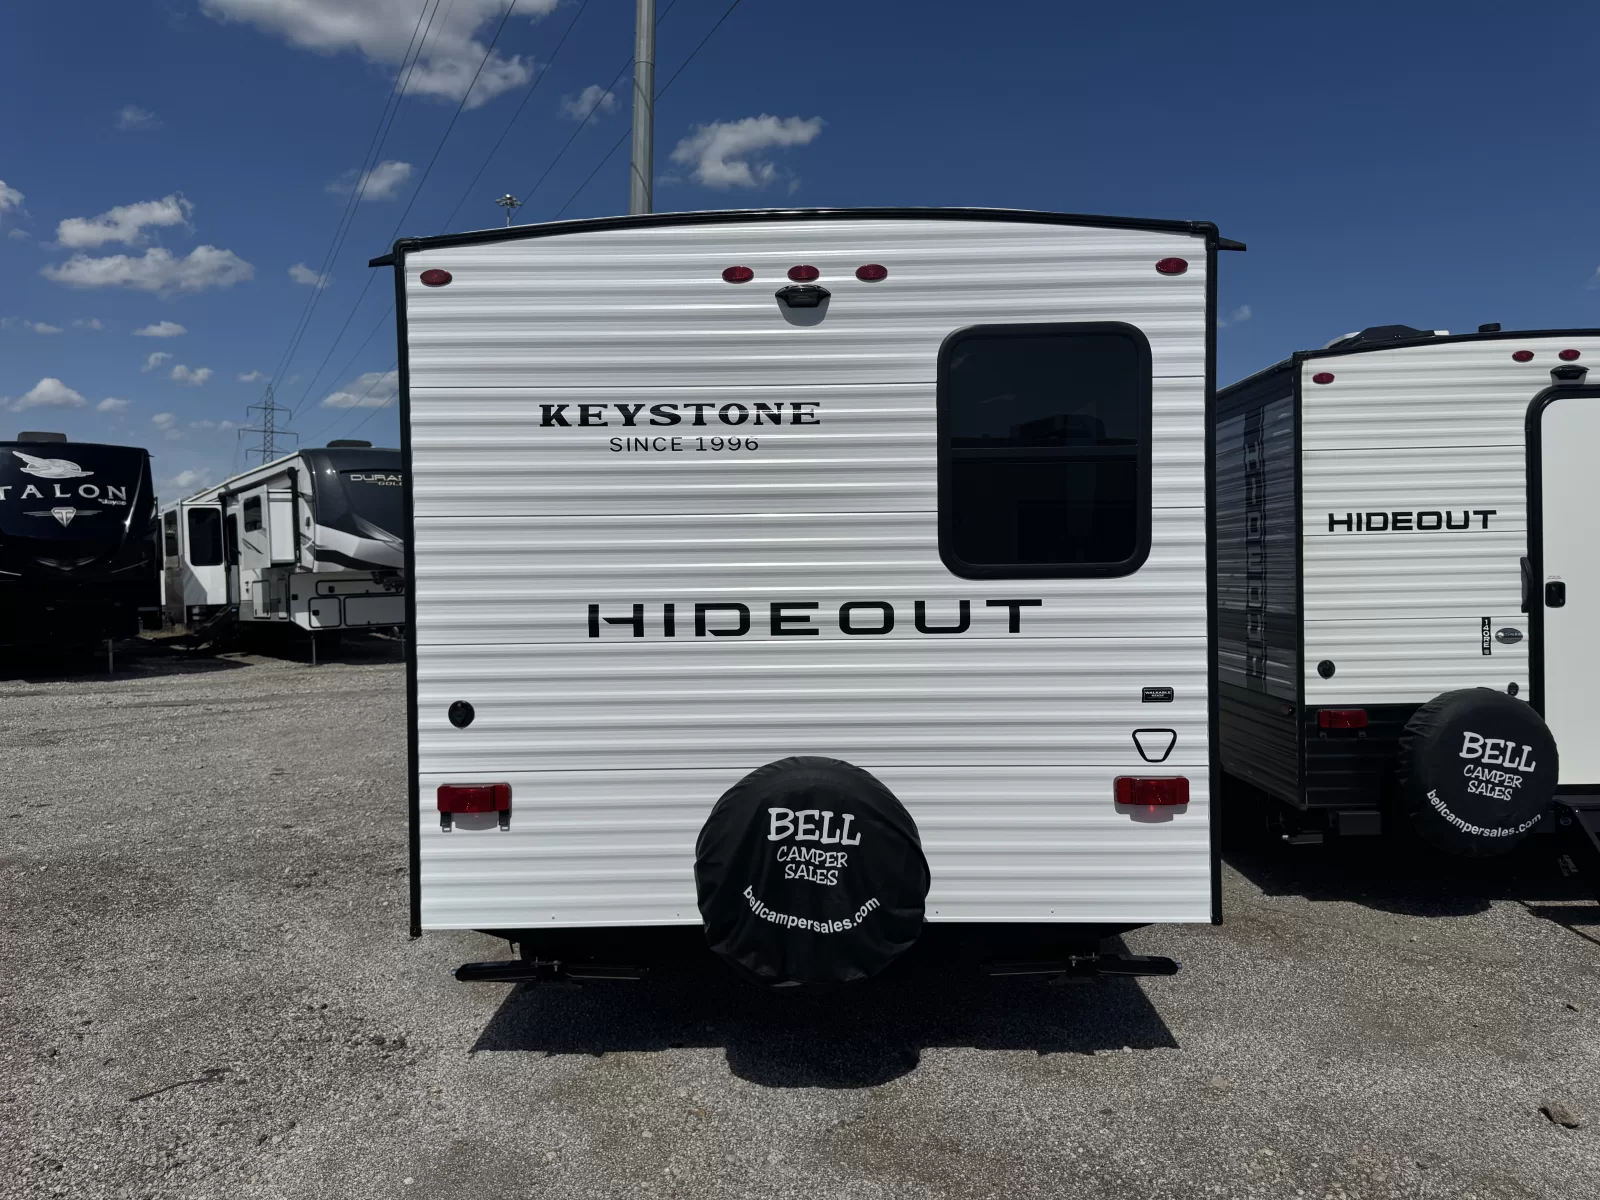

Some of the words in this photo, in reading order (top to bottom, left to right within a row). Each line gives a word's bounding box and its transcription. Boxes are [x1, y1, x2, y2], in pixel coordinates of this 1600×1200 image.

[539, 402, 821, 427] KEYSTONE
[609, 436, 683, 452] SINCE
[695, 436, 759, 451] 1996
[0, 484, 127, 500] TALON
[1328, 510, 1497, 532] HIDEOUT
[588, 599, 1042, 638] HIDEOUT
[1459, 731, 1536, 772] BELL
[1463, 764, 1523, 788] CAMPER
[1467, 780, 1513, 801] SALES
[1426, 789, 1542, 837] bellcampersales.com
[767, 807, 861, 846] BELL
[777, 846, 848, 868] CAMPER
[784, 864, 839, 886] SALES
[743, 885, 881, 934] bellcampersales.com
